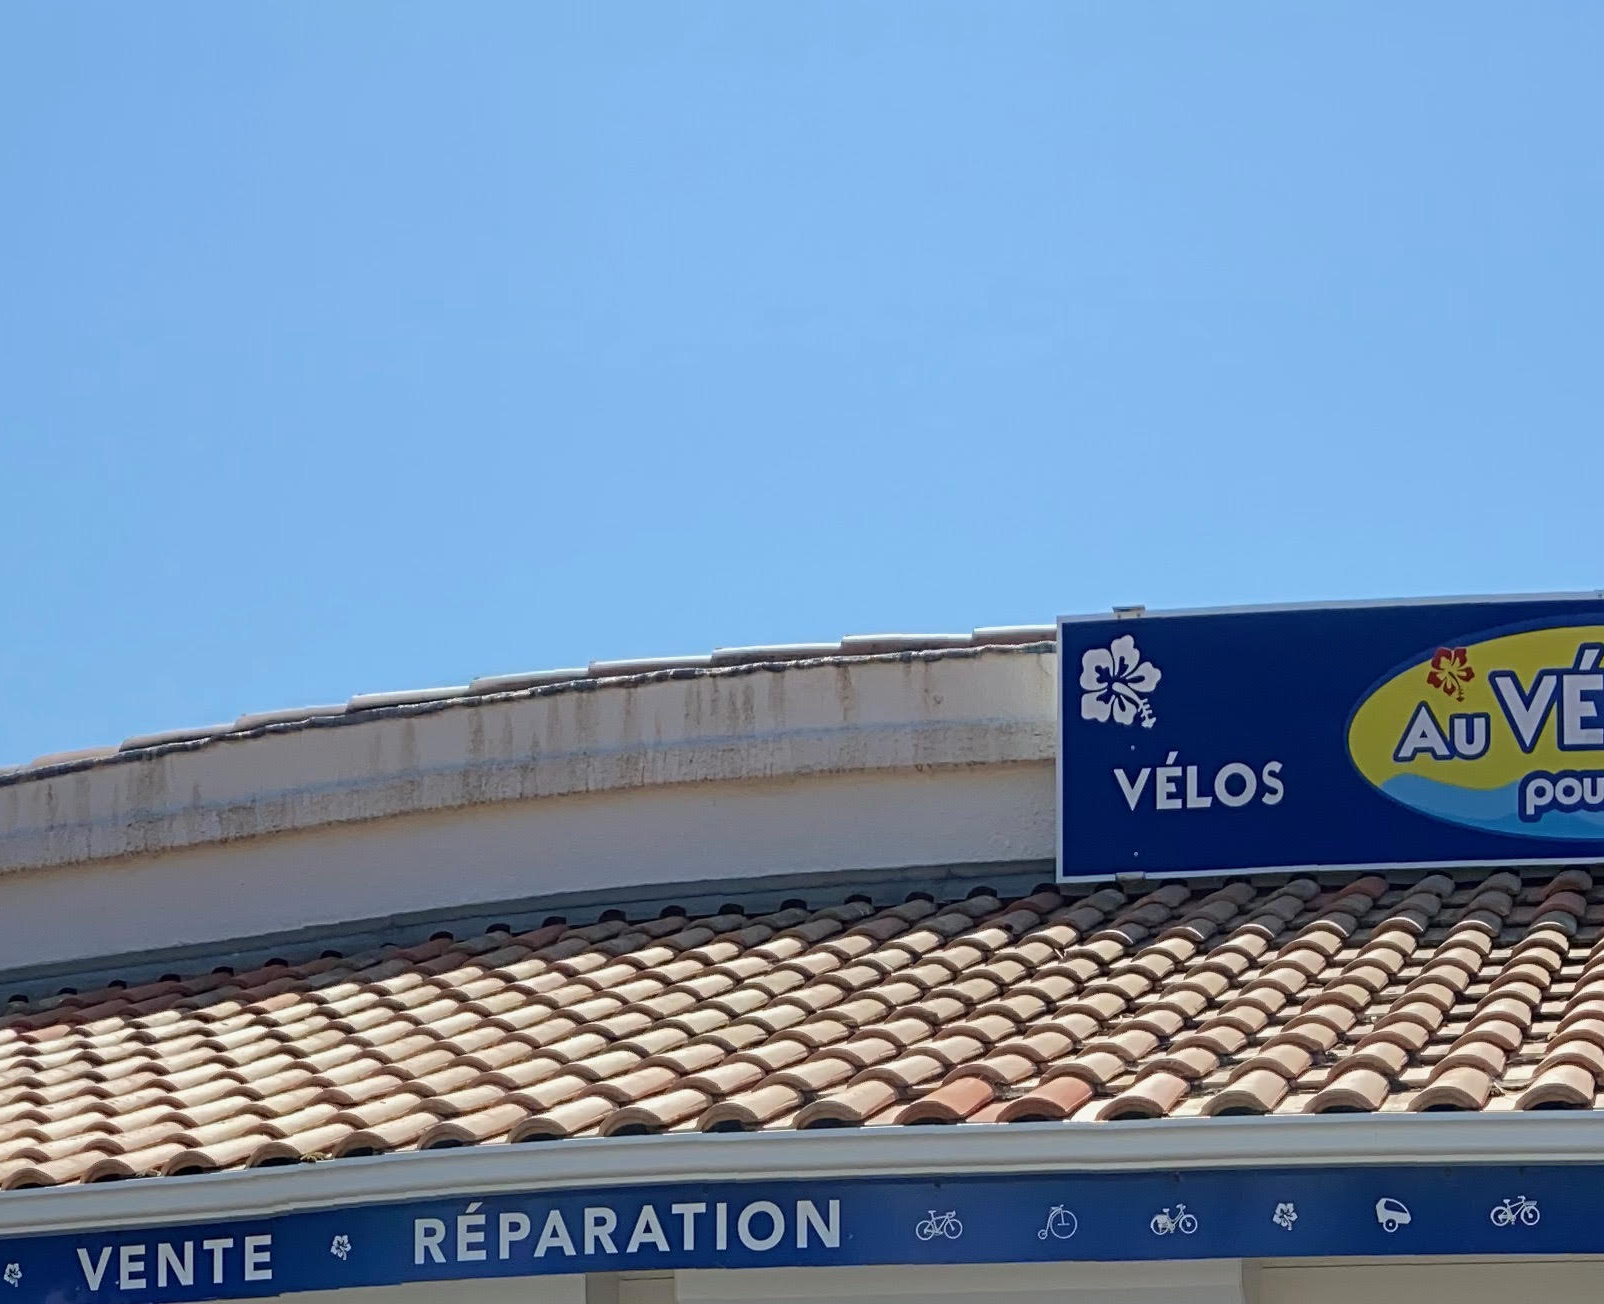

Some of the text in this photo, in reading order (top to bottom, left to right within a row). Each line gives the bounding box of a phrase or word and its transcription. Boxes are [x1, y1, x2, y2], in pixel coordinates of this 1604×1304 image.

[1113, 750, 1284, 812] VÉLOS
[76, 1233, 274, 1292] VENTE
[412, 1199, 845, 1265] RÉPARATION
